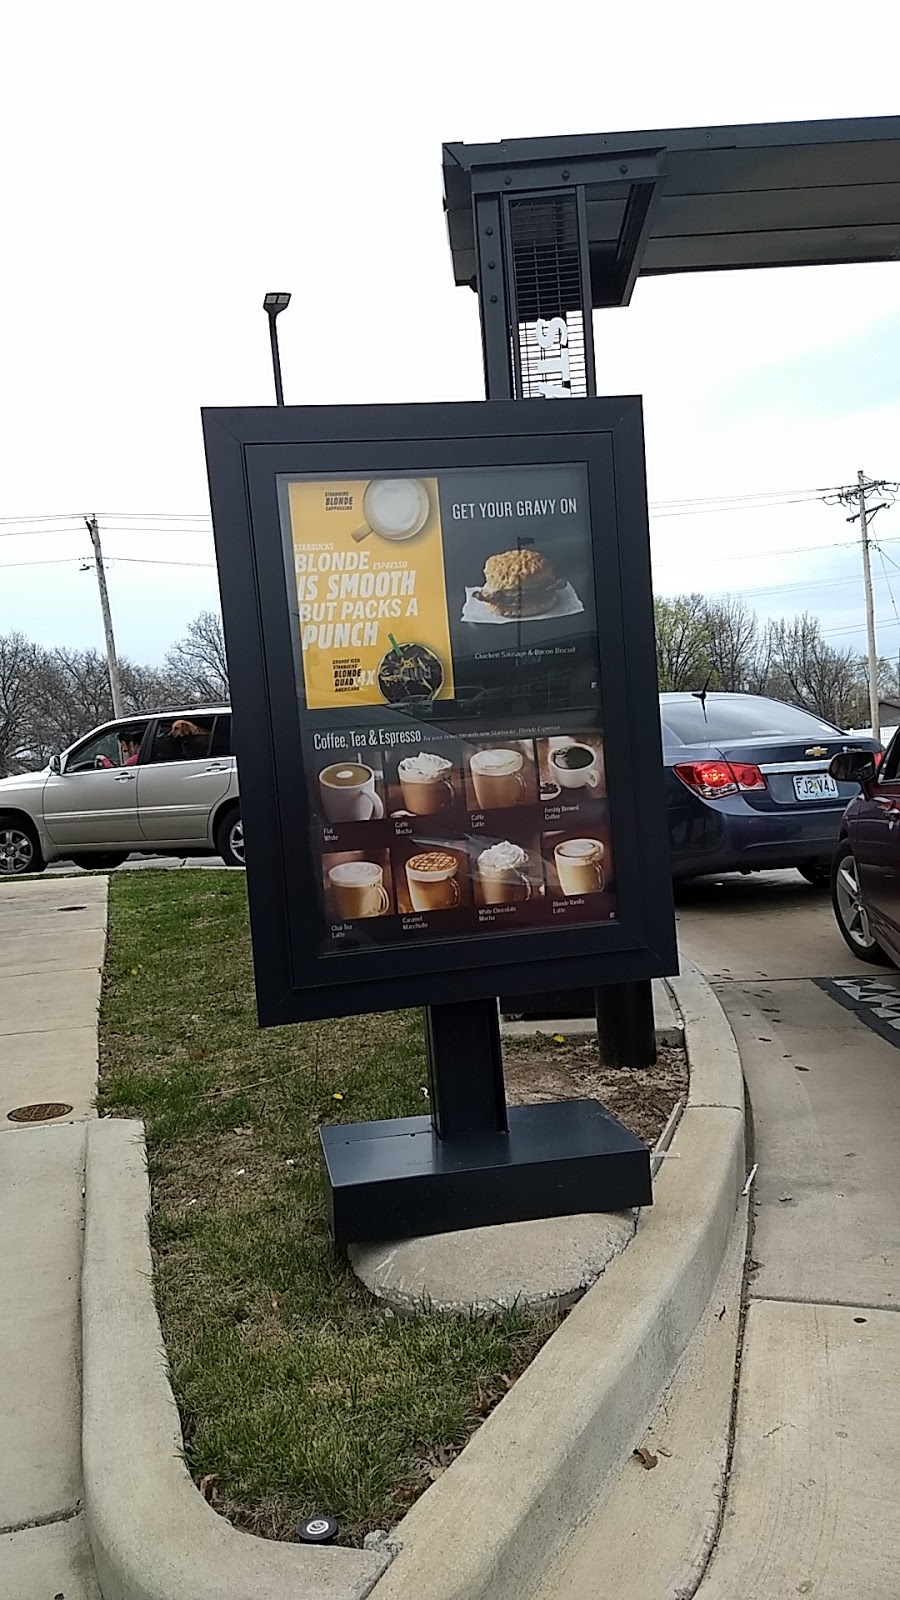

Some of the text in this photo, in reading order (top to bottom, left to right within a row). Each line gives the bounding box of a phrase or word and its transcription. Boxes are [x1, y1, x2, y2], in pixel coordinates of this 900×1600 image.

[325, 496, 354, 506] BLONDE
[452, 498, 577, 520] GET YOUR GRAVY ON
[294, 543, 334, 552] STARBUCKS
[295, 551, 408, 573] BLONDE ESPRESSO
[297, 570, 416, 601] IS SMOOTH
[300, 597, 418, 623] BUT PACKS A
[302, 621, 379, 651] PUNCH
[474, 652, 500, 660] Chicken
[500, 649, 527, 658] Sausage
[534, 647, 554, 656] Bacon
[554, 646, 576, 654] Biscuit
[333, 668, 361, 678] BLONDE
[334, 678, 354, 687] QUAD
[313, 728, 422, 750] Coffee, Tea & Espresso
[323, 834, 339, 842] White
[492, 906, 517, 914] Chocolate
[478, 914, 495, 922] Mocha
